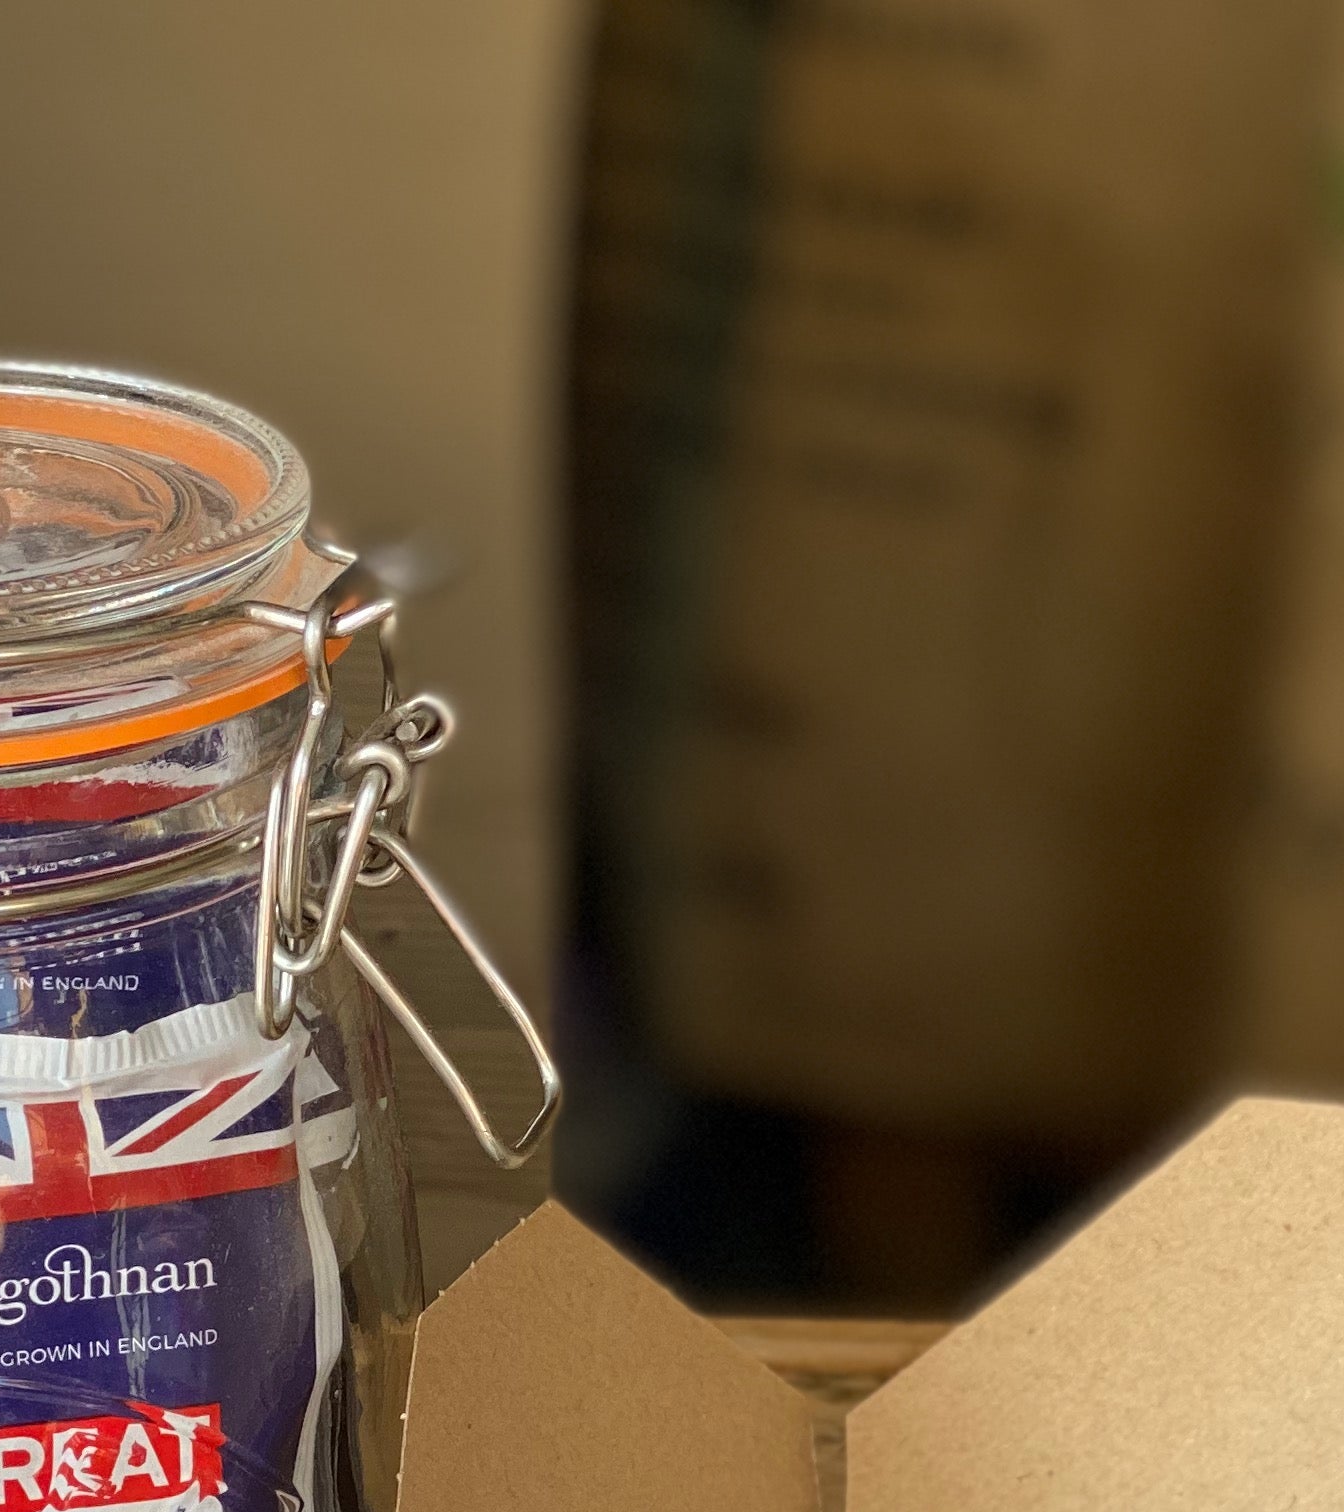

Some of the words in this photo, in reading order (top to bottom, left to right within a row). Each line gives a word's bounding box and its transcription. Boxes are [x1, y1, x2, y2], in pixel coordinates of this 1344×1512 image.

[41, 974, 140, 992] ENGLAND
[0, 1343, 82, 1368] GROWN
[89, 1339, 111, 1358] IN
[118, 1328, 219, 1355] ENGLAND
